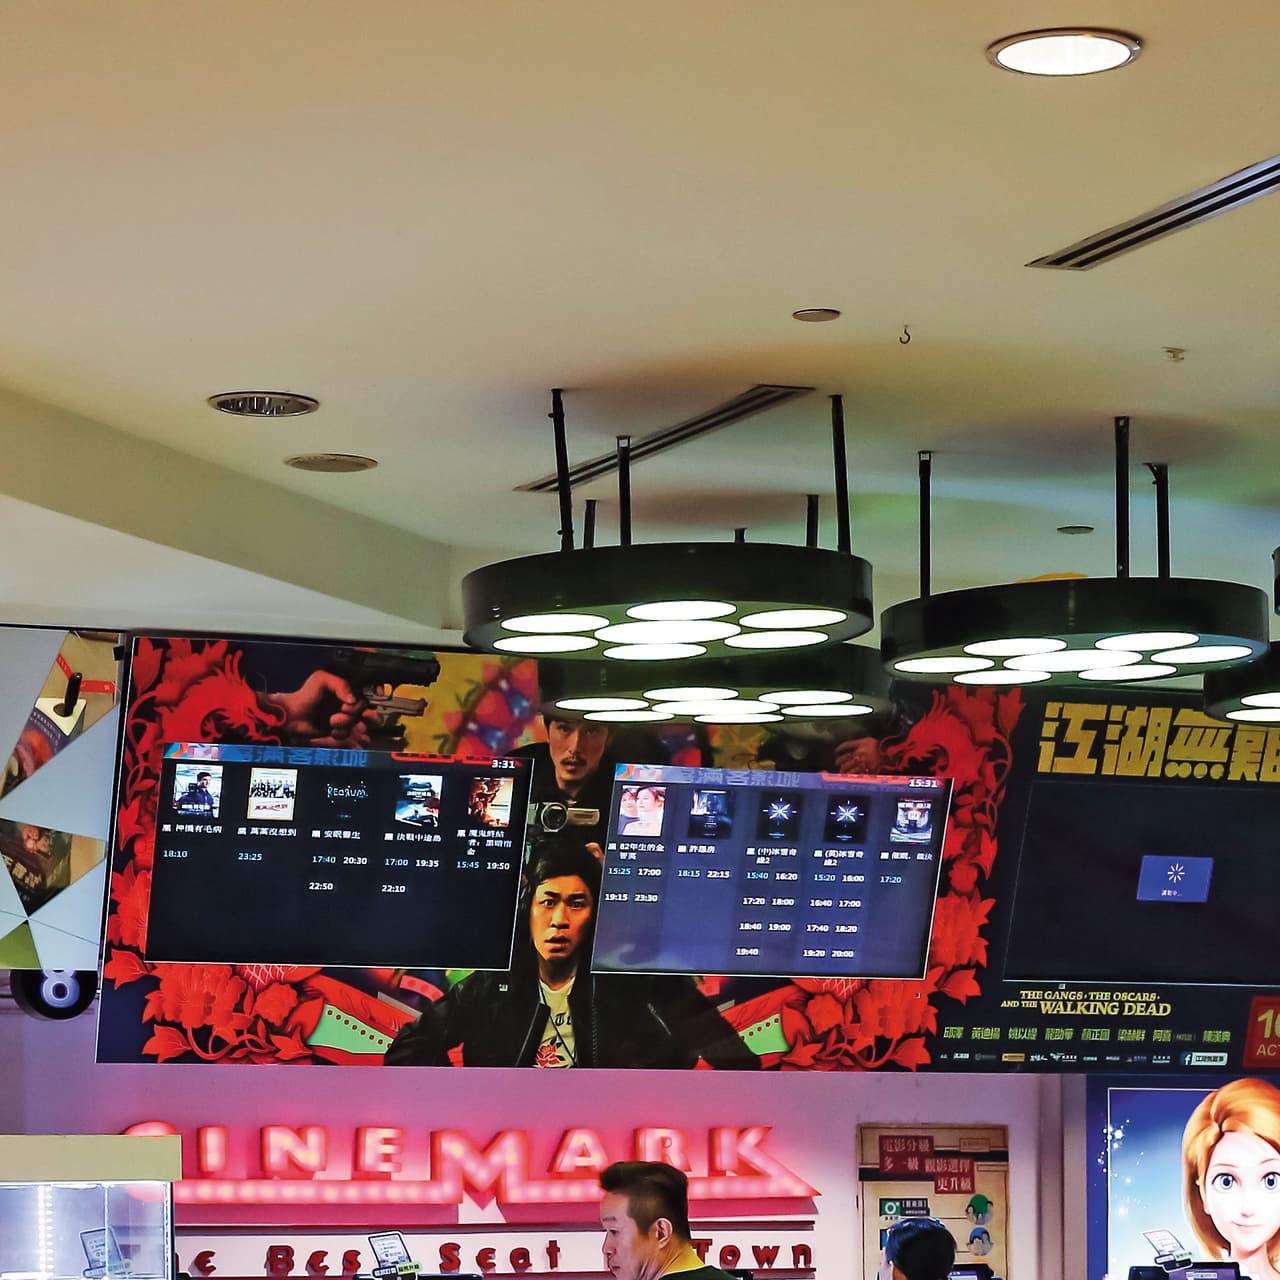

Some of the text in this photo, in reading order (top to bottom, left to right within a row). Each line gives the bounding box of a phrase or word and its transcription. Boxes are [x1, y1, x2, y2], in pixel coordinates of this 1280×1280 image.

[909, 778, 938, 788] 15:31
[163, 849, 188, 859] 18:10
[237, 852, 263, 861] 23:25
[311, 855, 368, 866] 17:40 20:30
[384, 857, 440, 868] 17:00 19:35
[456, 860, 511, 871] 15:45 19:50
[608, 867, 662, 877] 15:25 17:00
[706, 870, 731, 879] 22:15
[746, 871, 798, 881] 15:40 16:20
[814, 873, 865, 883] 15:20 16:00
[880, 875, 902, 884] 17:20
[308, 881, 334, 891] 22:50
[381, 884, 406, 894] 22:10
[605, 893, 658, 902] 19:15 23:30
[742, 897, 795, 906] 17:20 18:00
[838, 899, 861, 908] 17:00
[739, 922, 791, 932] 18:40 19:00
[806, 924, 858, 933] 17:40 18:20
[803, 949, 854, 958] 19:20 20:00
[1021, 990, 1157, 1002] THE GANGS THE OSCARS
[1001, 1000, 1171, 1017] AND THE WALKING DEAD
[123, 1120, 822, 1211] INEMARK
[267, 1239, 814, 1275] Bes Seat Town
